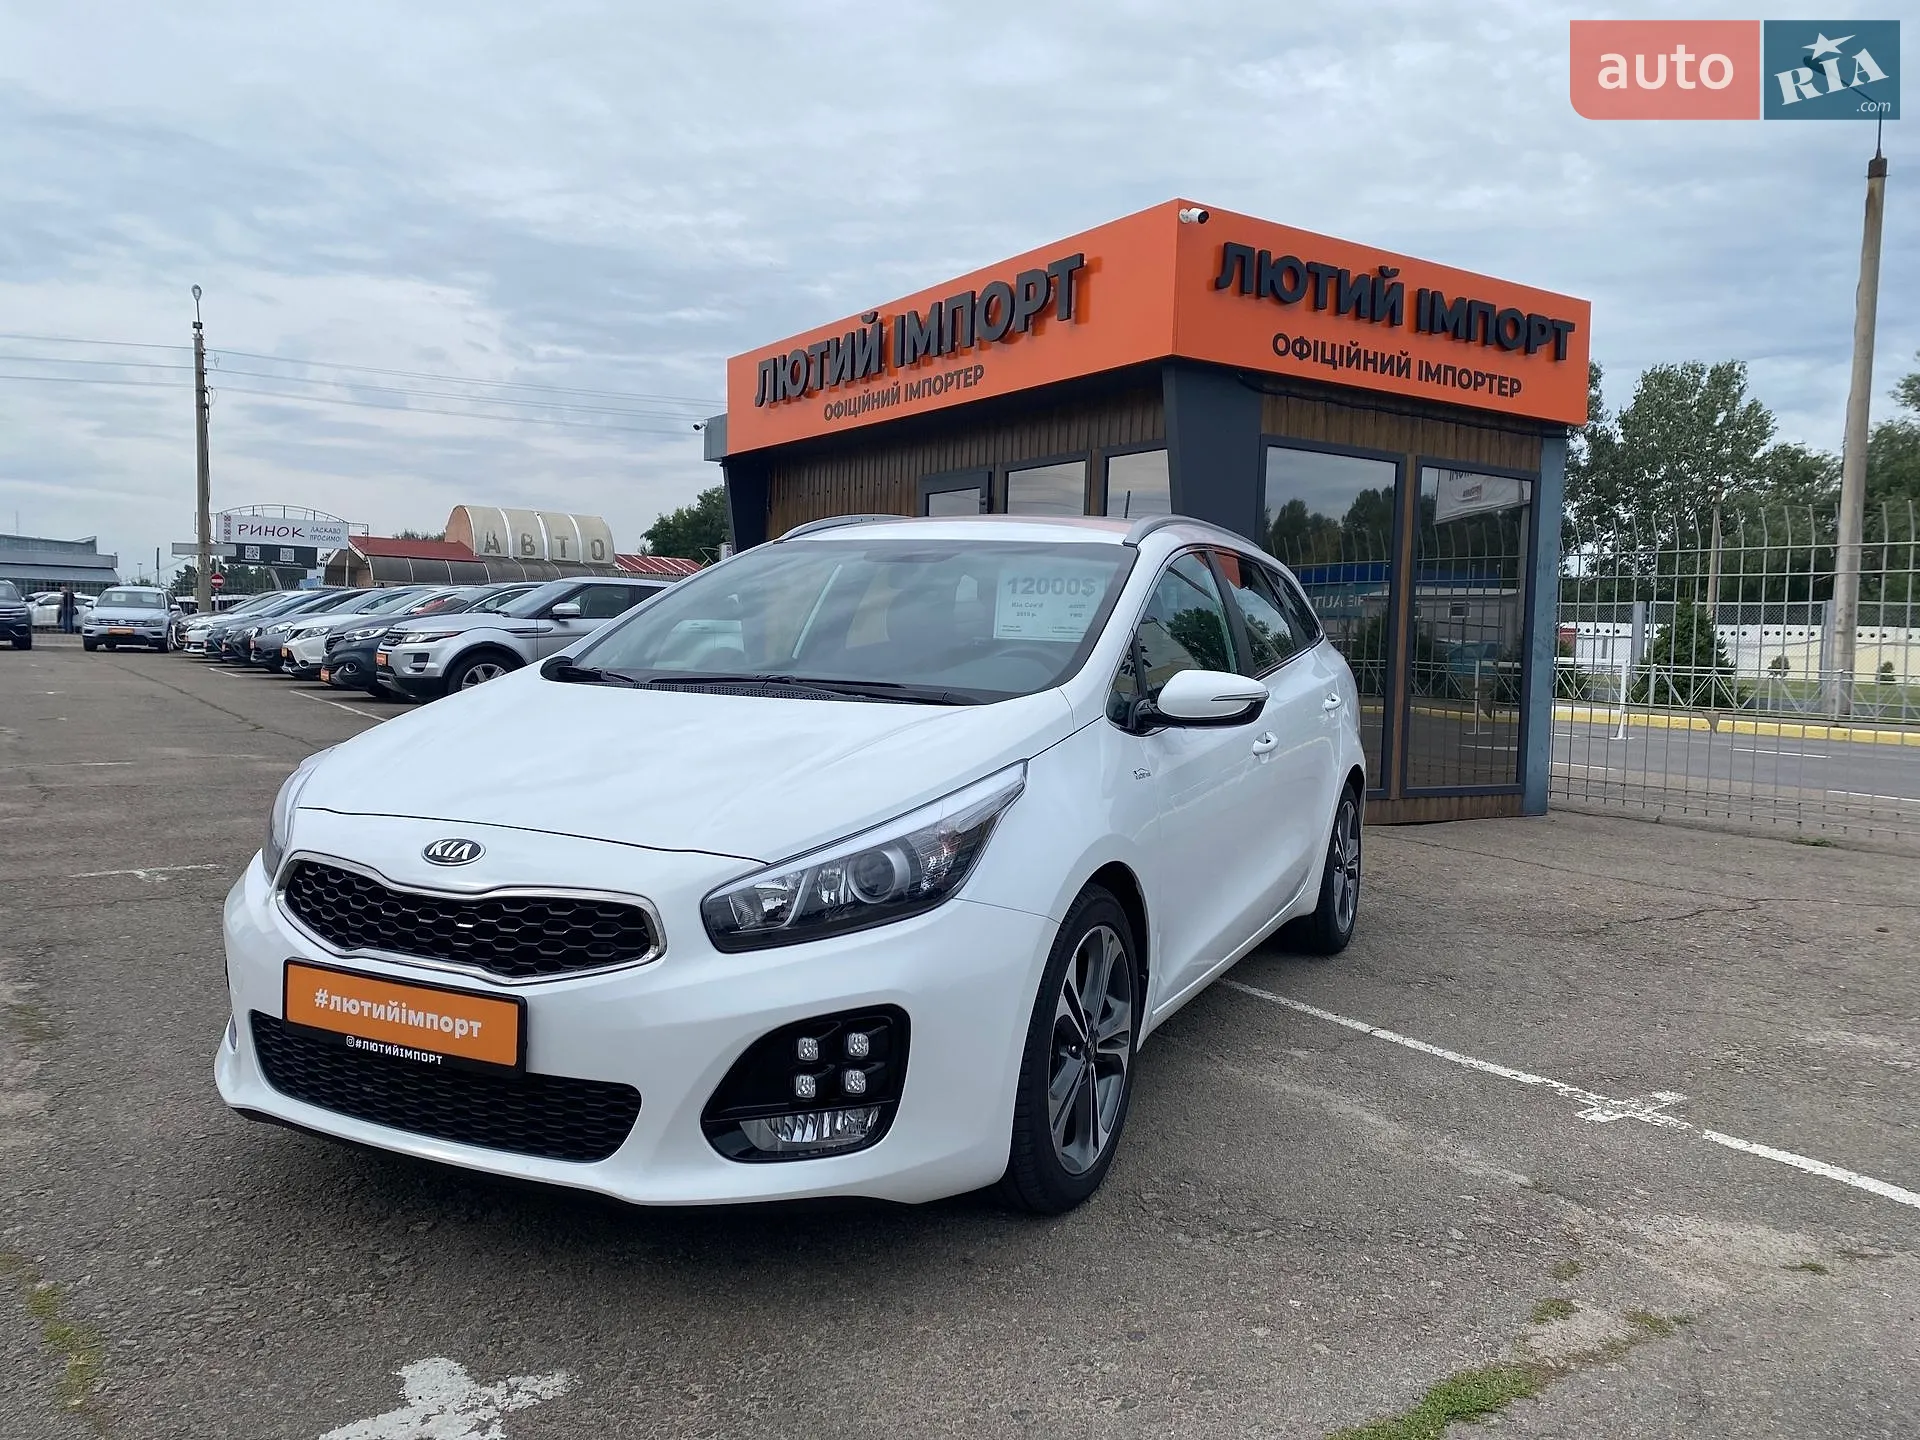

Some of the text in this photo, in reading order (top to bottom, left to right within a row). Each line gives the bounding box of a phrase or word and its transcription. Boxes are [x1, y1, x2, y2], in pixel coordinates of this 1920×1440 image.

[1215, 241, 1575, 361] ЛЮТИЙ ІМПОРТ
[754, 252, 1085, 408] ЛЮТИЙ ІМПОРТ
[1272, 332, 1523, 398] ОФІЦІЙНИЙ ІМПОРТЕР
[823, 364, 985, 422] ОФІЦІЙНИЙ ІМПОРТЕР
[237, 523, 305, 539] РИНОК
[310, 526, 341, 535] ЛАСКАВО
[484, 530, 606, 561] АВТО
[1007, 577, 1096, 597] 12000$
[427, 840, 473, 860] KIA
[314, 988, 482, 1039] #лютийімпорт
[355, 1038, 443, 1066] #ЛЮТИЙІМПОРТ
